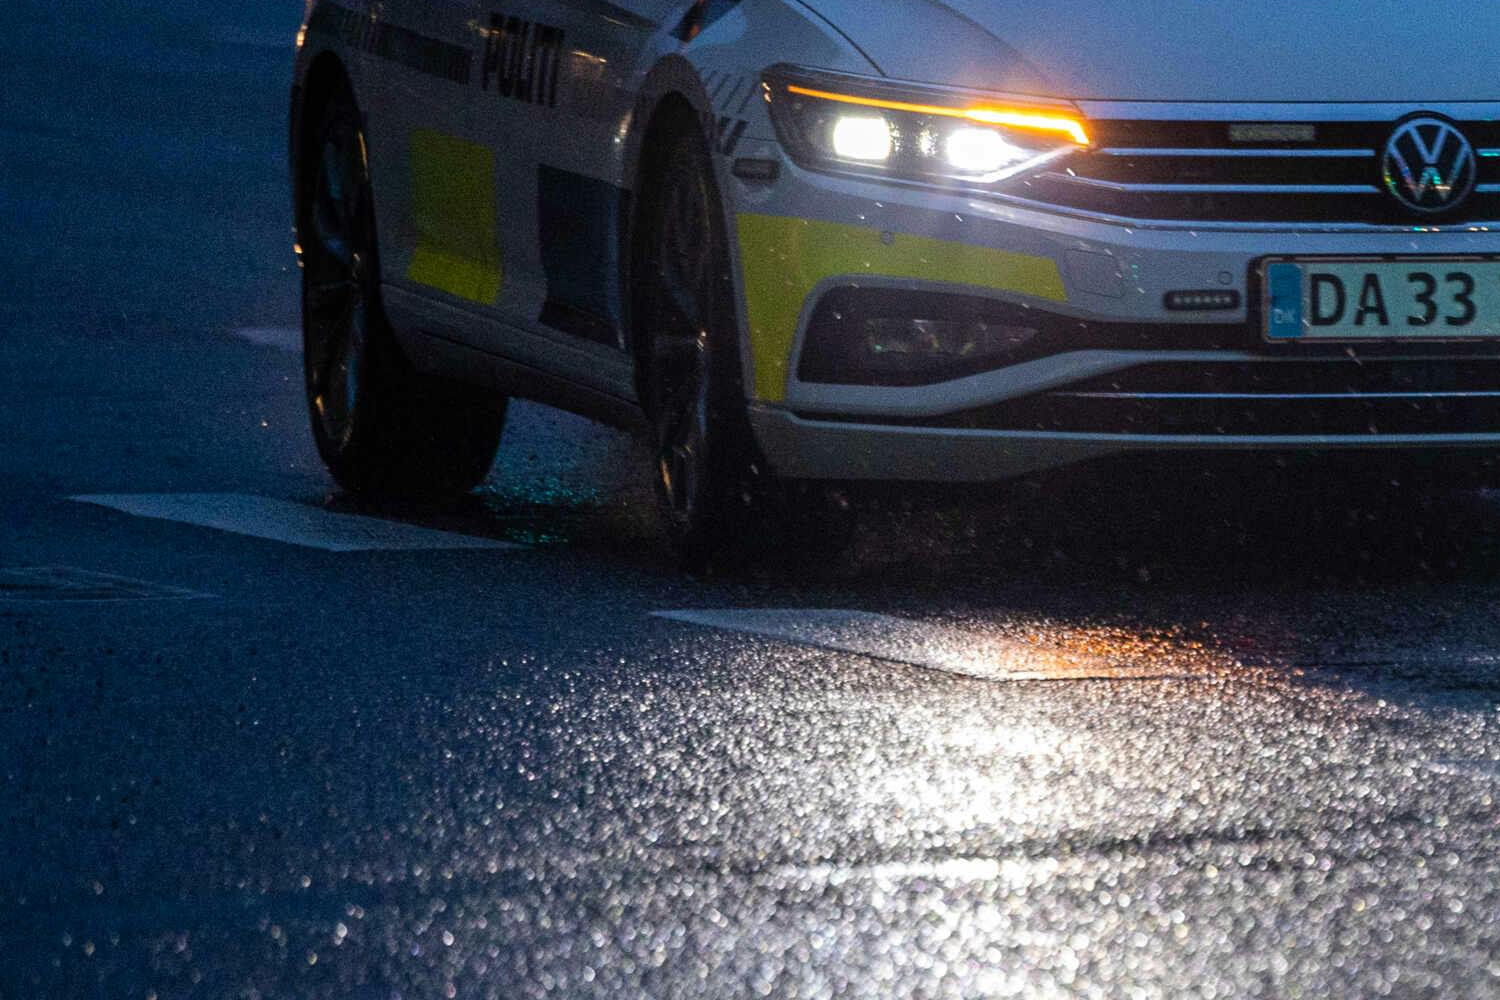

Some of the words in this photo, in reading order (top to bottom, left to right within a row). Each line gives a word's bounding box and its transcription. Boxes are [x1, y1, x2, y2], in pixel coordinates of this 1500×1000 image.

[482, 12, 565, 108] POLITI
[1384, 116, 1474, 206] VW
[1273, 308, 1296, 326] DK
[1310, 273, 1389, 326] DA
[1407, 271, 1476, 326] 33
